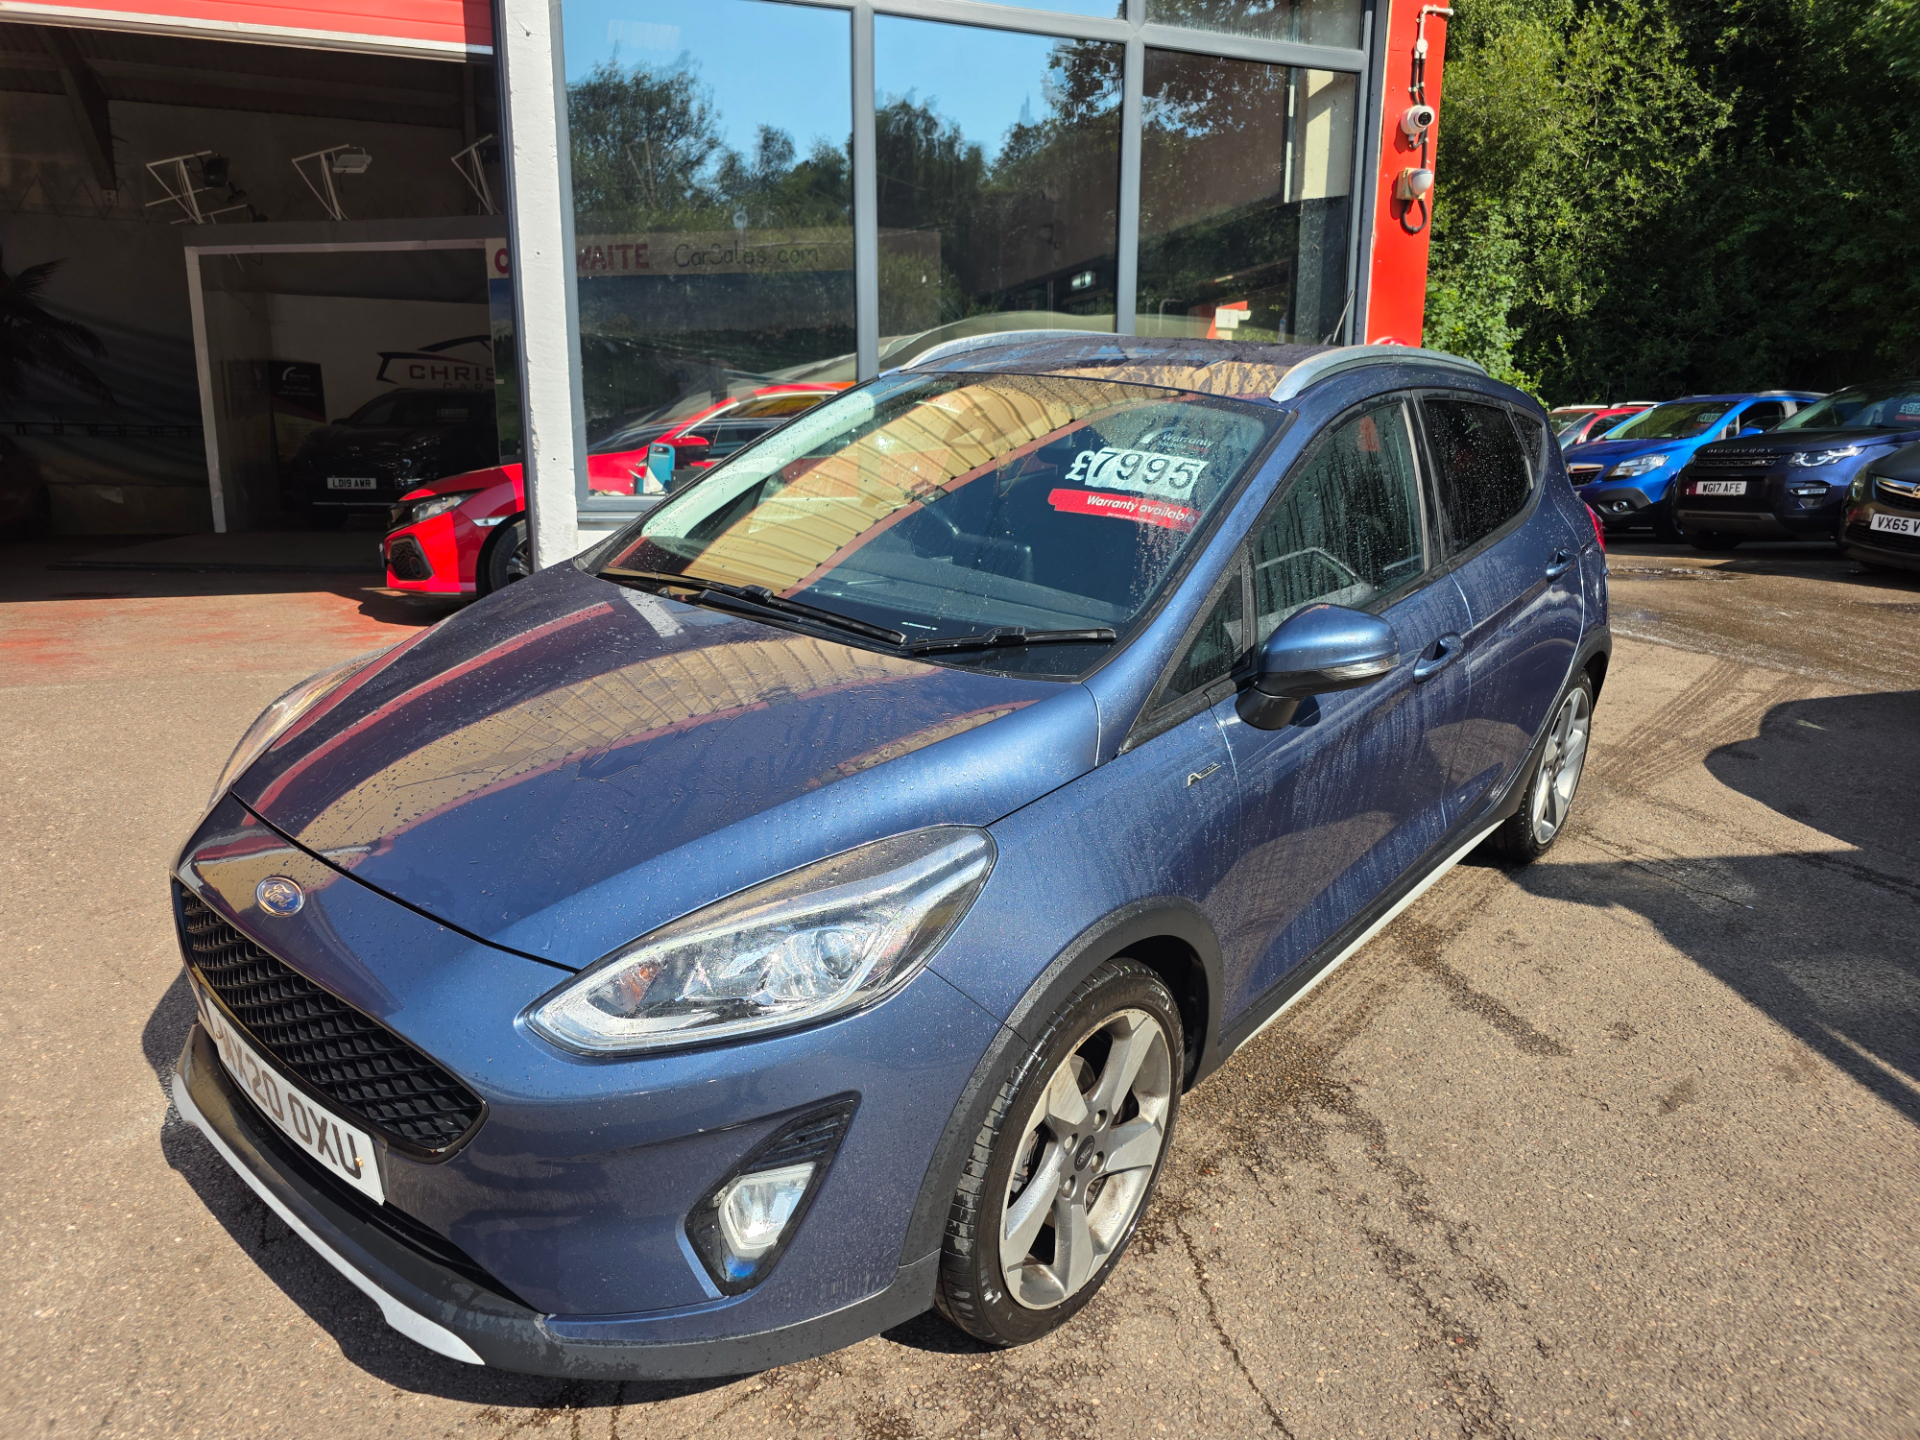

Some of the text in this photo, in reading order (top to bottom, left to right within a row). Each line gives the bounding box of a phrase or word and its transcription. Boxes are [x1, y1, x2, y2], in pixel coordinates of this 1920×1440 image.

[409, 364, 494, 381] CHRIS
[1065, 450, 1199, 490] £7995
[333, 479, 371, 488] LD19 AWR
[1702, 482, 1741, 492] WG17 AFE
[1087, 494, 1139, 513] Warranty
[1138, 503, 1195, 523] available
[1878, 515, 1909, 532] VX65
[265, 884, 294, 908] Ford
[287, 1092, 362, 1180] OXU
